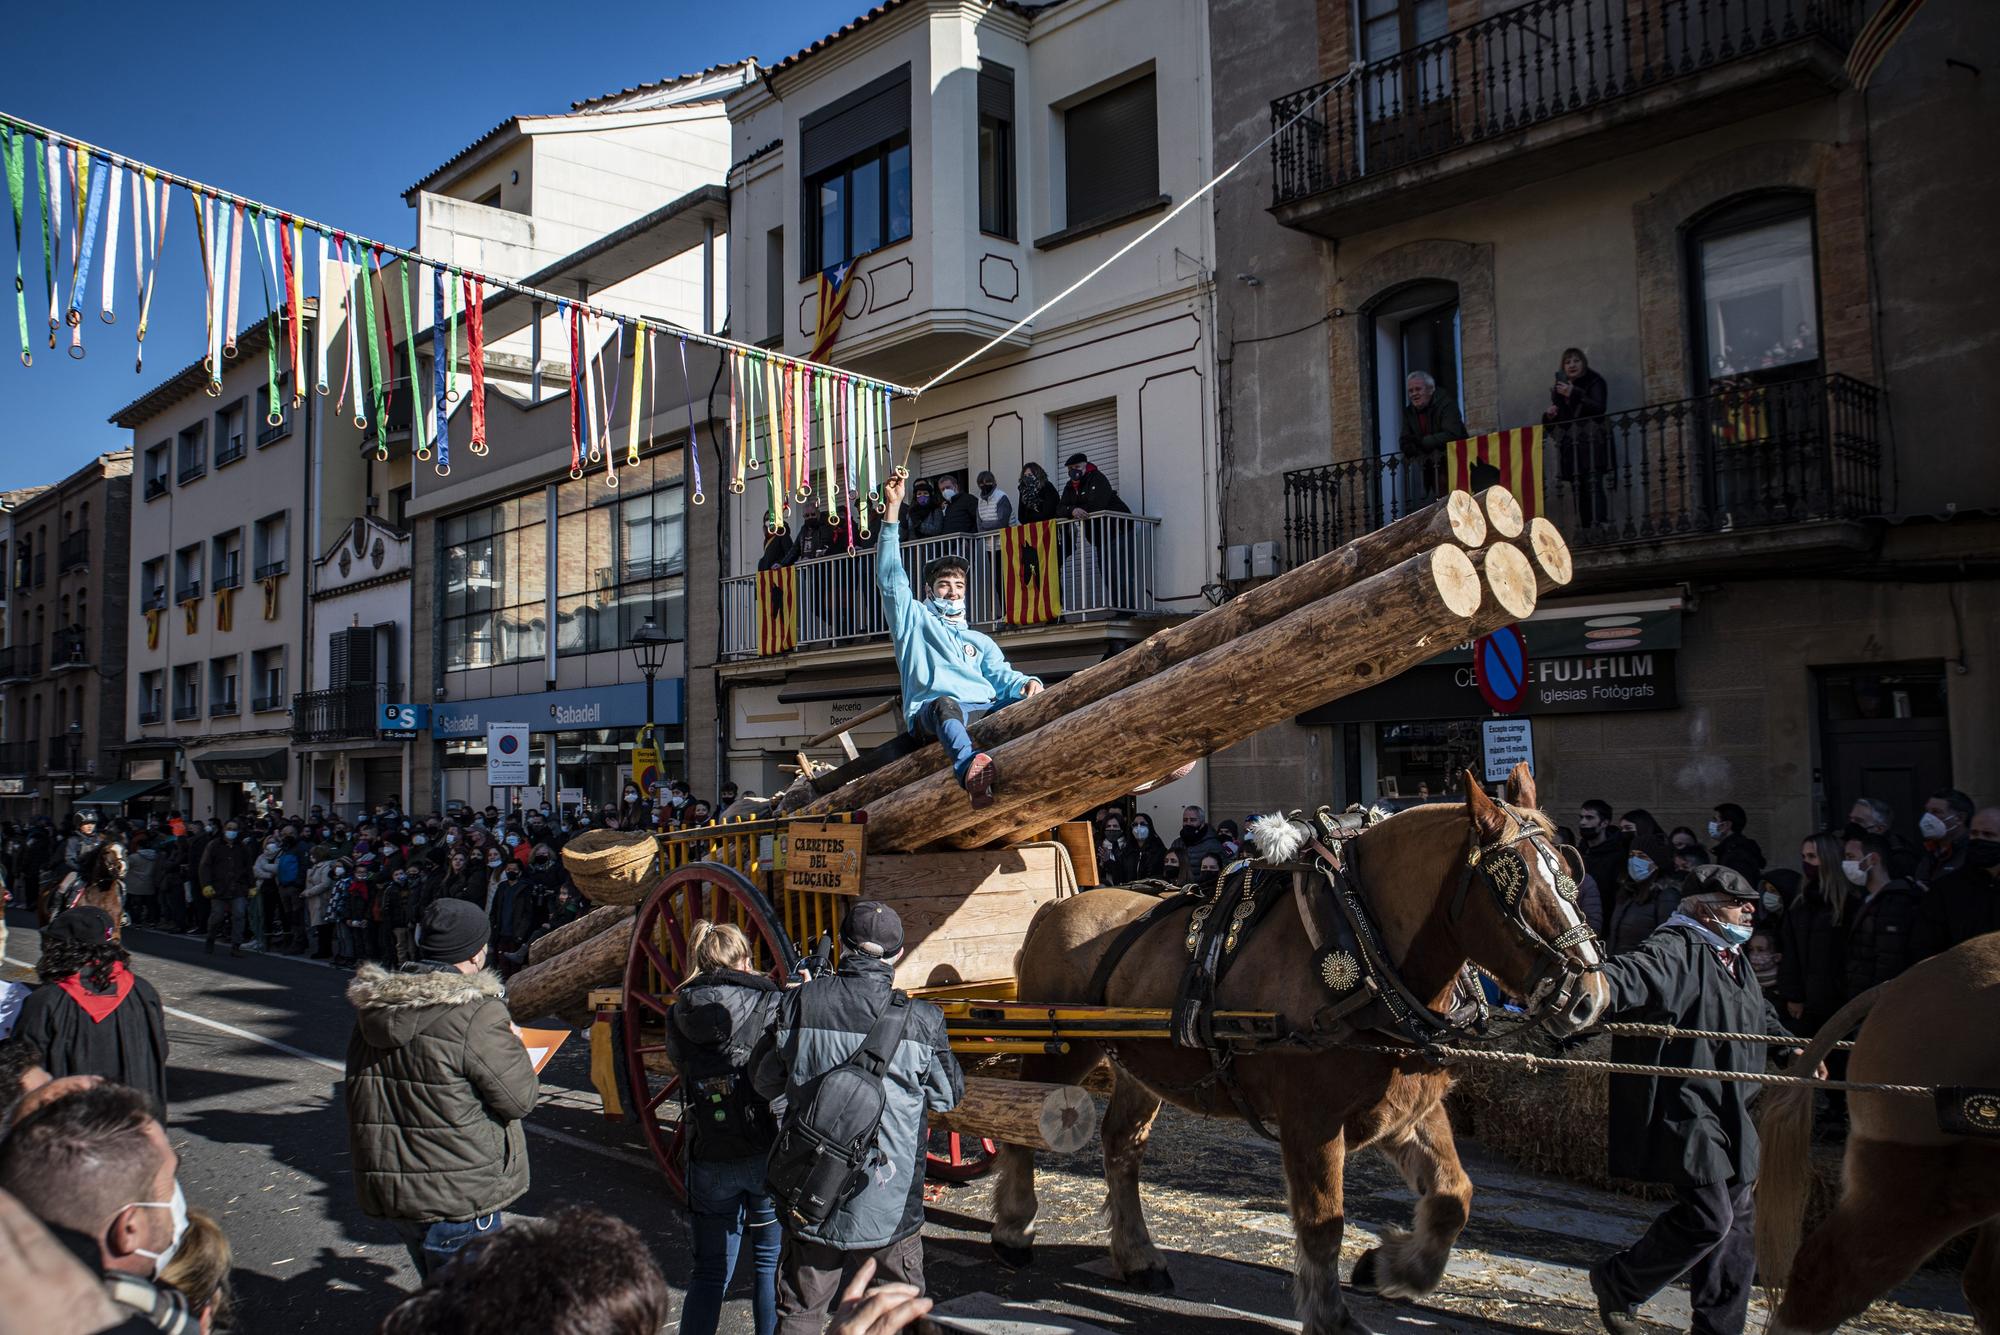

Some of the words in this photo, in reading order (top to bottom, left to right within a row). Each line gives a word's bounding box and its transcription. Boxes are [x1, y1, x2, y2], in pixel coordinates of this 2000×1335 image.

[1540, 654, 1654, 682] FUJIFILM
[1541, 688, 1588, 704] Iglesias
[1592, 683, 1655, 701] Fotògrafs
[556, 703, 600, 724] Sabadell
[831, 701, 862, 712] Merceria
[443, 714, 479, 733] Sabadell
[795, 838, 844, 853] CARRETERS
[809, 855, 827, 868] DEL
[793, 871, 842, 888] LLUÇANÈS
